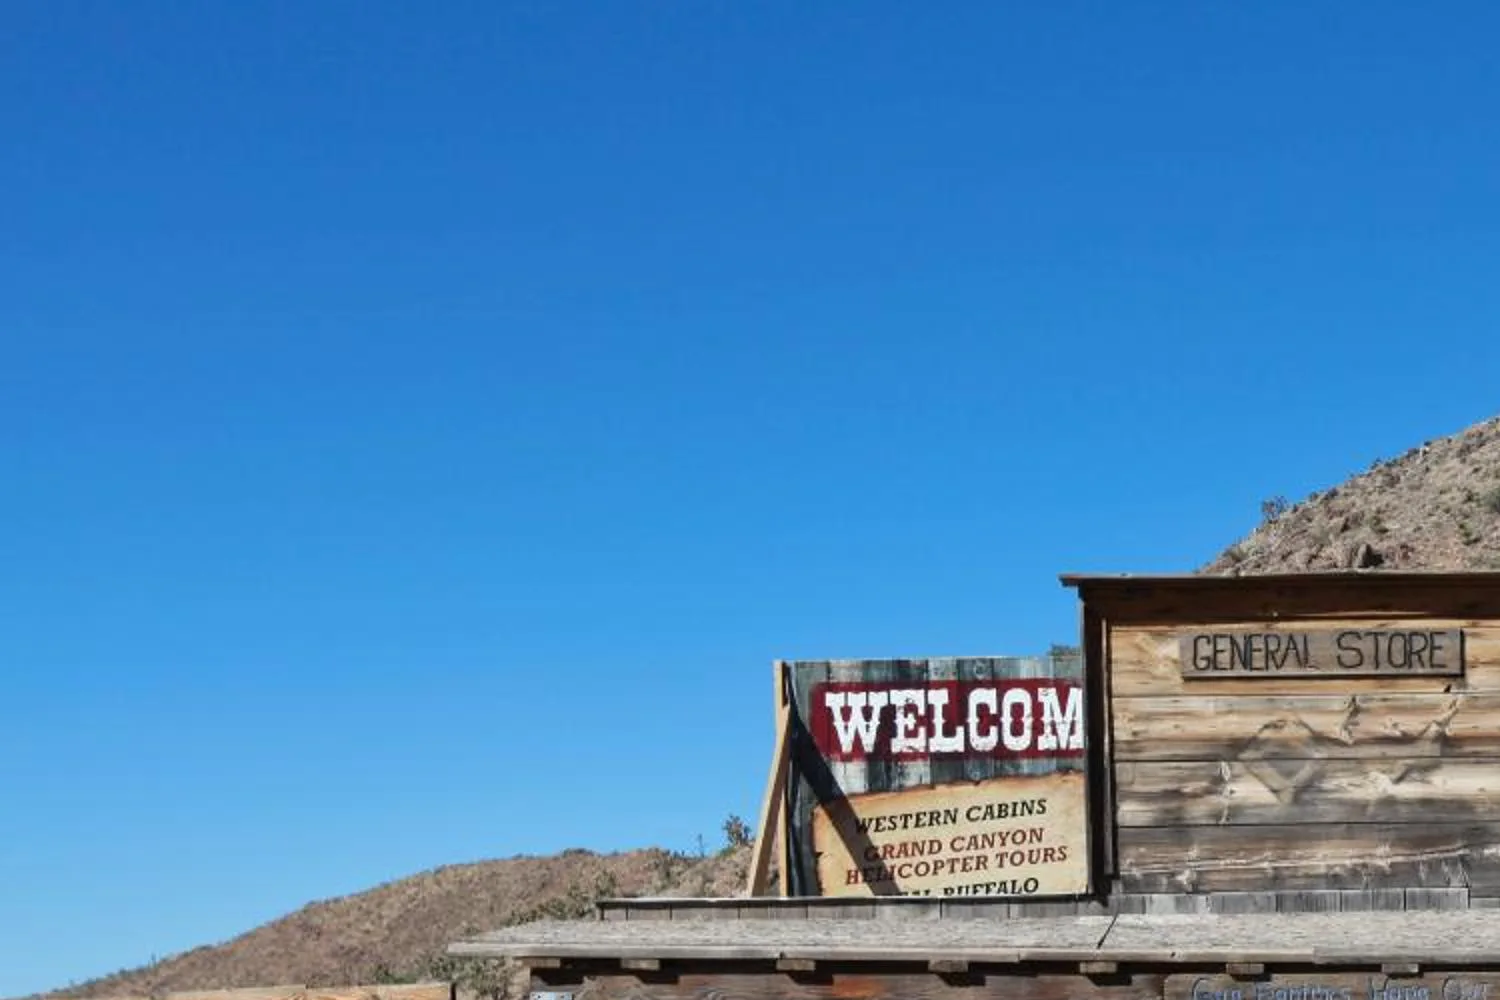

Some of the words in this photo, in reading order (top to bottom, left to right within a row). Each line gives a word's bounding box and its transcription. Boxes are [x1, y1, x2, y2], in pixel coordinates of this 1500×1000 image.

[1192, 633, 1316, 672] GENERAL
[1336, 630, 1448, 670] STORE
[855, 807, 959, 834] WESTERN
[965, 798, 1047, 823] CABINS
[864, 839, 942, 862] GRAND
[950, 827, 1045, 853] CANYON
[845, 853, 988, 885] HELICOPTER
[995, 845, 1069, 868] TOURS
